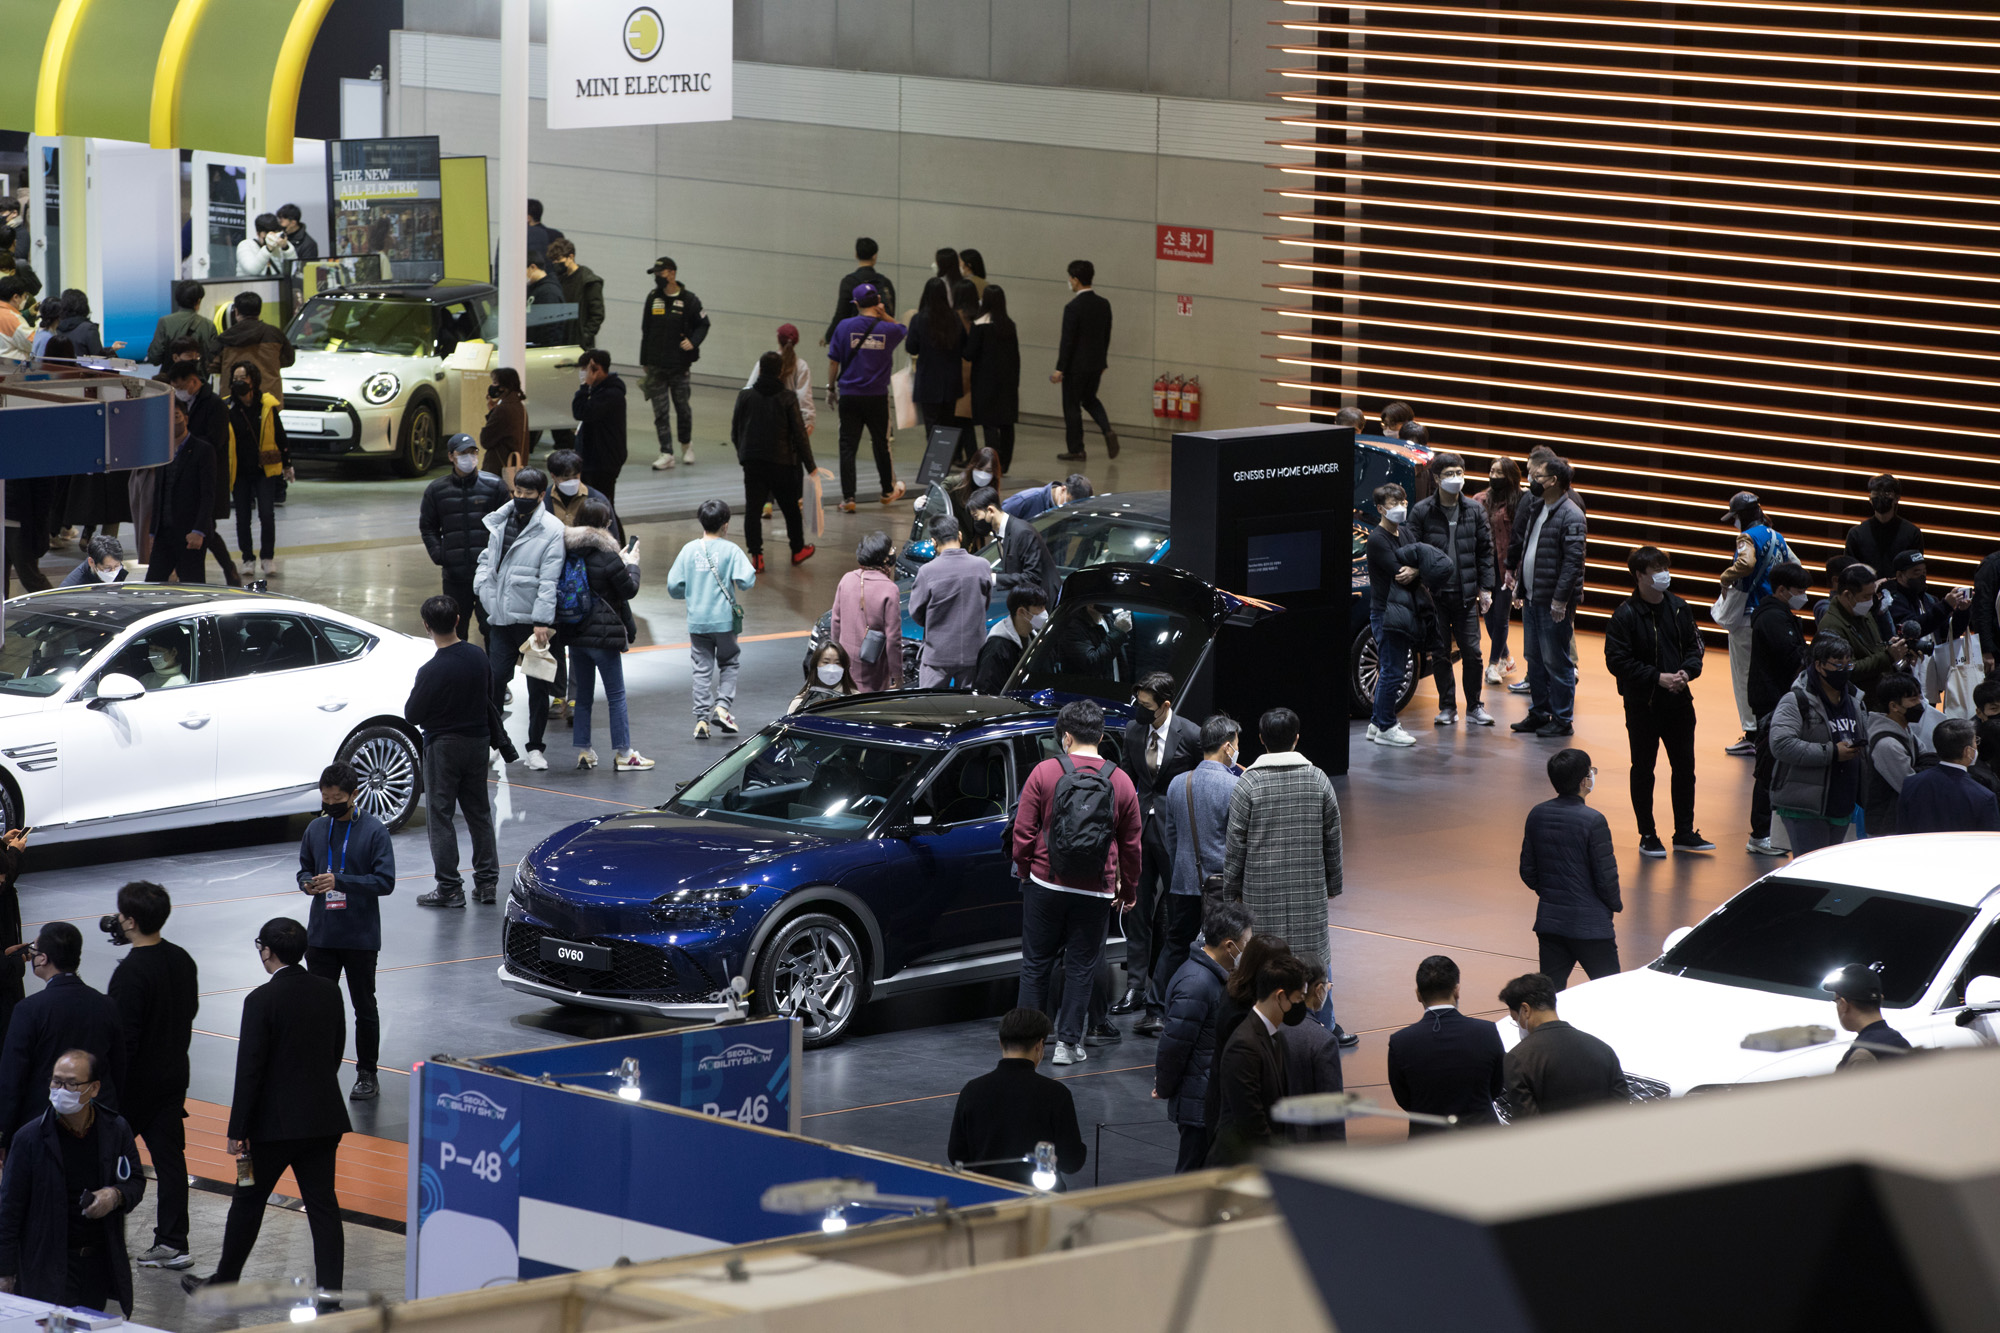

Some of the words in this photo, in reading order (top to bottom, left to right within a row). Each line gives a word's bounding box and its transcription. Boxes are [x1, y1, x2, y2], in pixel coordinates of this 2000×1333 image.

[576, 77, 619, 98] MINI
[624, 73, 712, 96] ELECTRIC
[339, 169, 363, 182] THE
[364, 168, 391, 181] NEW
[340, 182, 418, 197] ALL-ELECTRIC
[1163, 230, 1207, 251] 소화기
[1163, 247, 1174, 256] Fire
[1174, 248, 1206, 259] Extinguisher
[1233, 469, 1265, 482] GENESIS
[1266, 468, 1276, 479] EV
[1277, 466, 1301, 478] HOME
[1302, 463, 1339, 475] CHARGER
[558, 947, 584, 962] GV60
[727, 1049, 753, 1058] SEOUL
[698, 1060, 741, 1071] MOBILITY
[743, 1054, 771, 1065] SHOW
[437, 1099, 477, 1114] MOBILITY
[477, 1106, 506, 1120] SHOW
[463, 1096, 488, 1107] SEOUL
[440, 1141, 502, 1183] P-48
